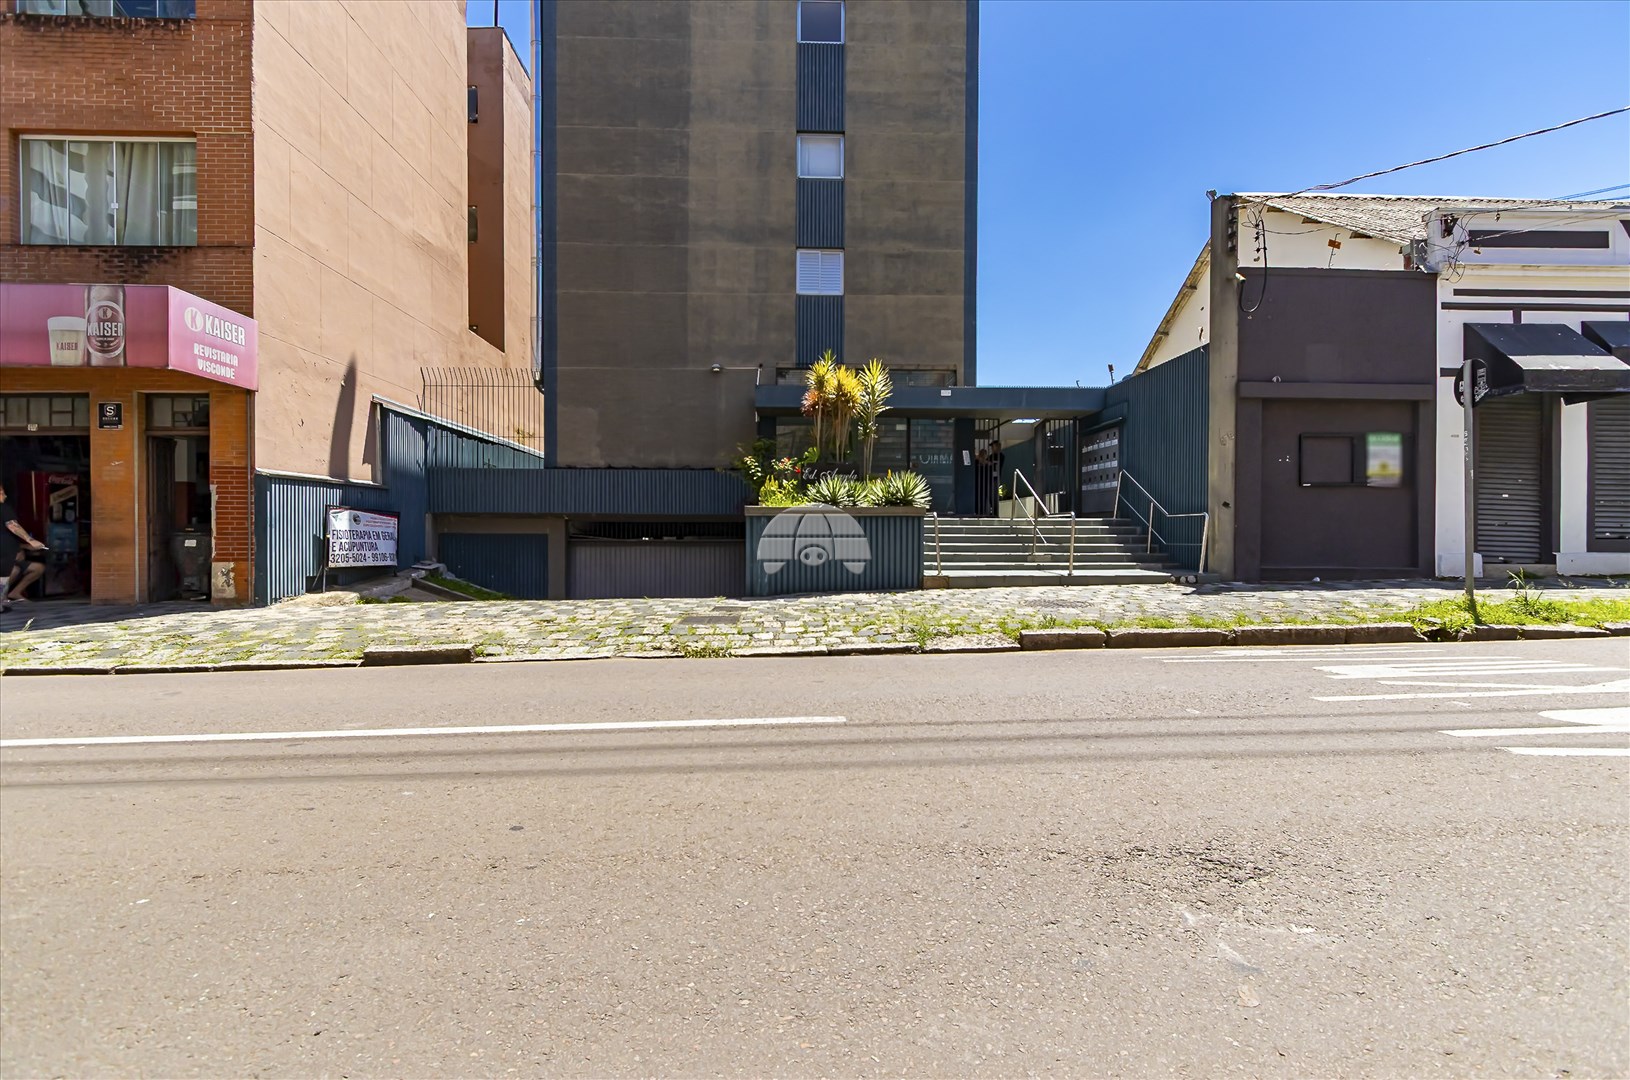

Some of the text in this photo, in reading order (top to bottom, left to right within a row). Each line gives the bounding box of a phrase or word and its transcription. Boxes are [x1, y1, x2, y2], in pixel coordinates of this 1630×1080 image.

[87, 322, 124, 337] KAISER
[204, 313, 246, 347] KAISER
[193, 342, 239, 367] REVISTARIA
[197, 358, 236, 380] VISCONDE
[106, 406, 115, 416] S
[332, 529, 372, 540] FISIOTERAPIA
[372, 530, 381, 540] EM
[332, 541, 379, 552] E ACUPUNTURA
[330, 553, 366, 563] 3205-5024
